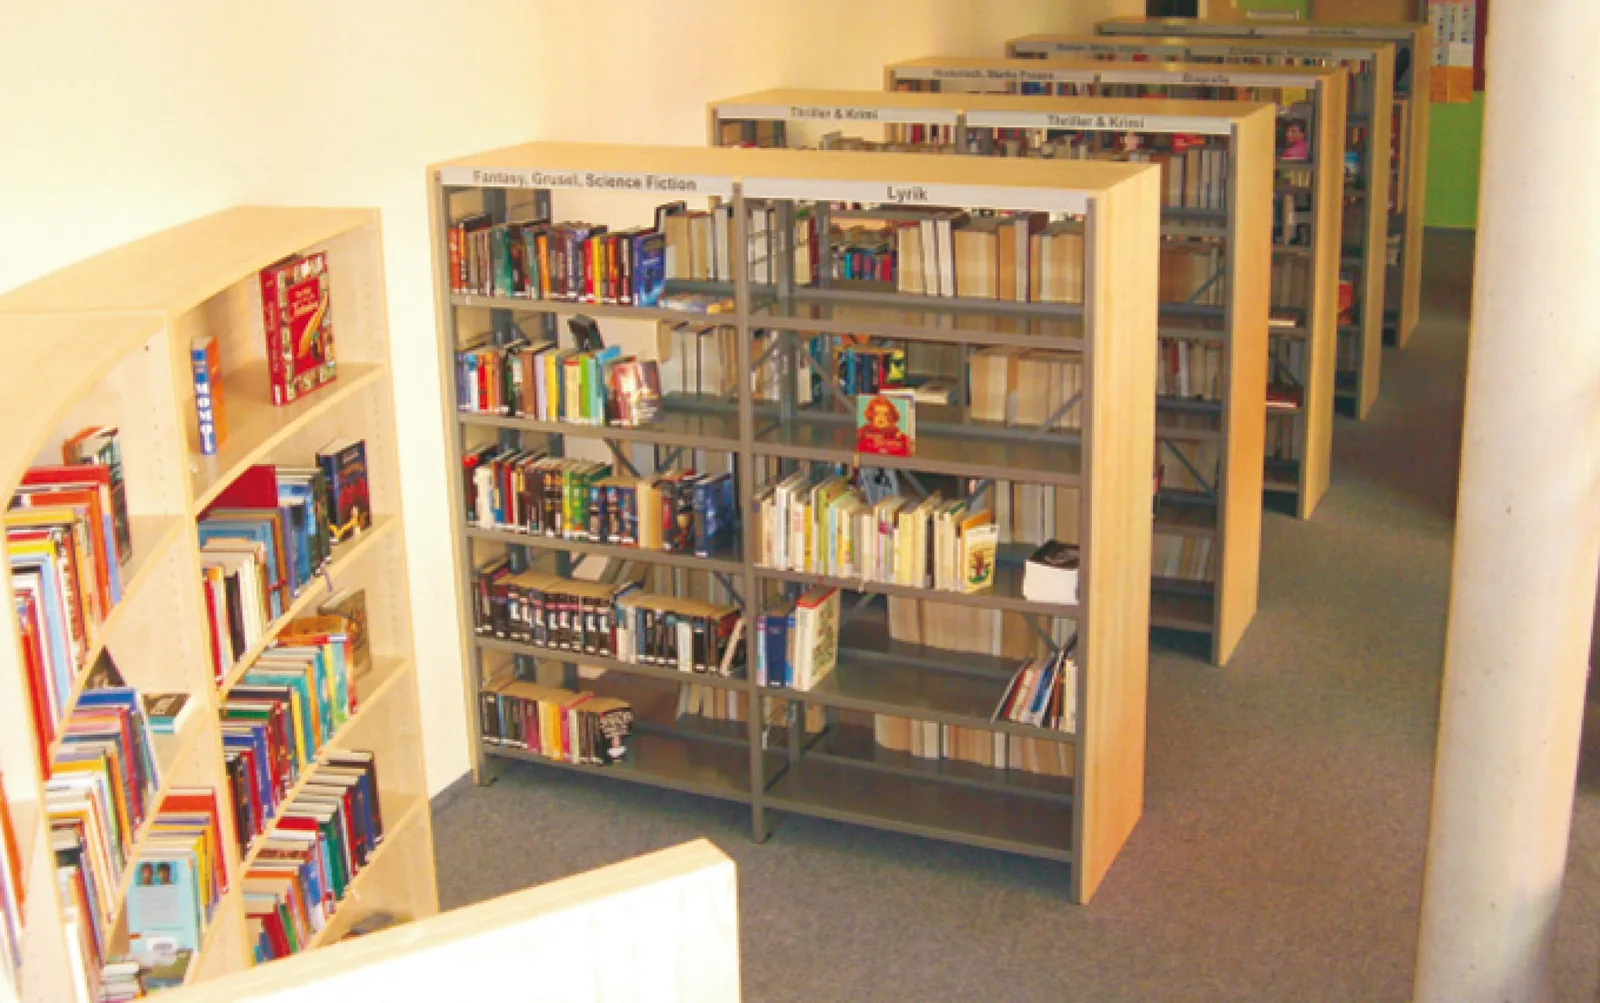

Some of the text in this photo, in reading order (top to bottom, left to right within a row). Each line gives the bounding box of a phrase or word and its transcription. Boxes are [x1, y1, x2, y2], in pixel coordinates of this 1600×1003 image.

[1047, 114, 1144, 128] Thriller & Krimi
[585, 172, 642, 188] Science
[645, 175, 698, 191] Fiction
[887, 186, 928, 204] Lyrik
